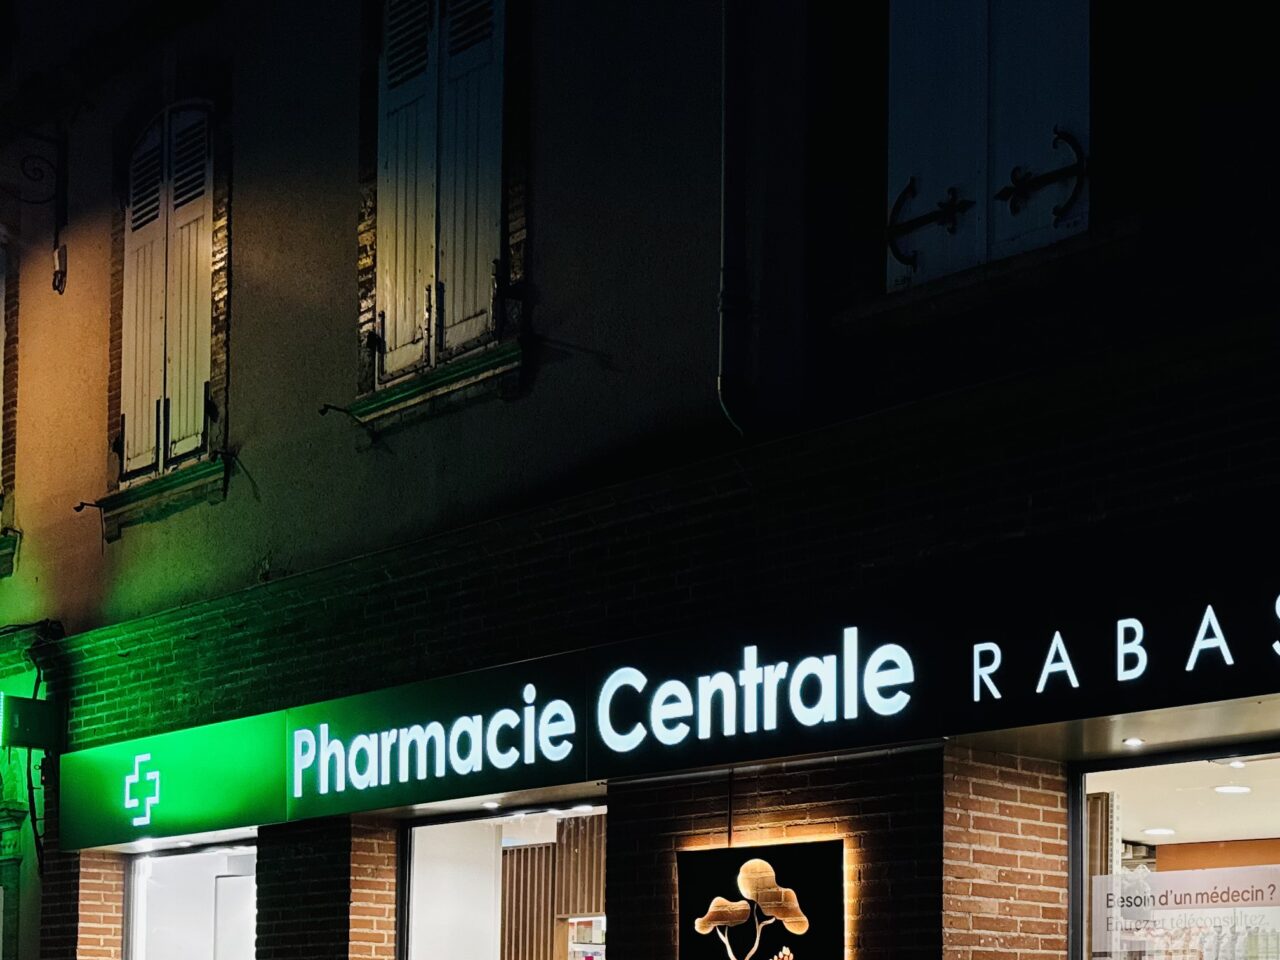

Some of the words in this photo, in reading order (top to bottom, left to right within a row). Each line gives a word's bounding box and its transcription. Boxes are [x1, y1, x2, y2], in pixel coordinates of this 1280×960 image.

[293, 683, 576, 798] Pharmacie
[597, 626, 915, 752] Centrale
[1106, 892, 1155, 908] Besoin
[1158, 890, 1191, 906] d'un
[1195, 885, 1263, 904] médecin
[1268, 884, 1276, 900] ?
